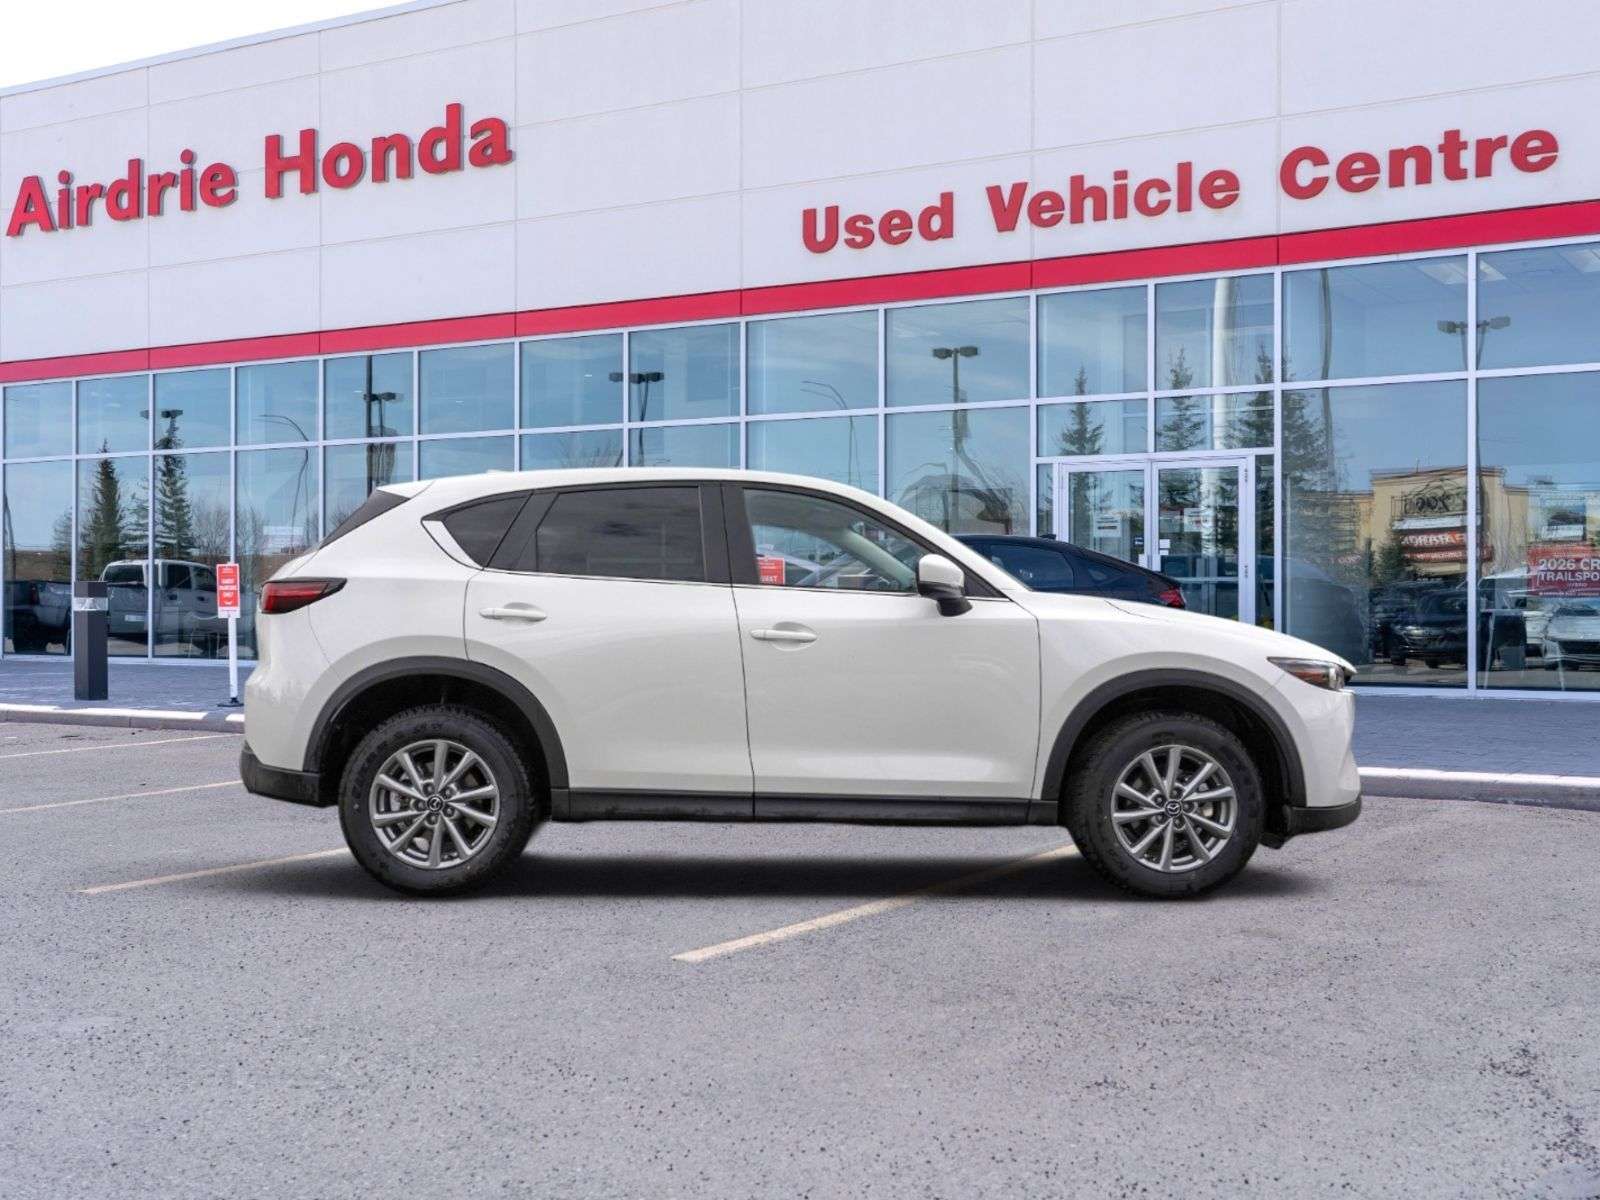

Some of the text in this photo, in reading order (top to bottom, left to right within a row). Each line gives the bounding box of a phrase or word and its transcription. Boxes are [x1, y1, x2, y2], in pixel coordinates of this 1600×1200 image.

[6, 102, 513, 237] Airdrie Honda
[802, 129, 1560, 253] Used Vehicle Centre
[1539, 558, 1576, 571] 2026
